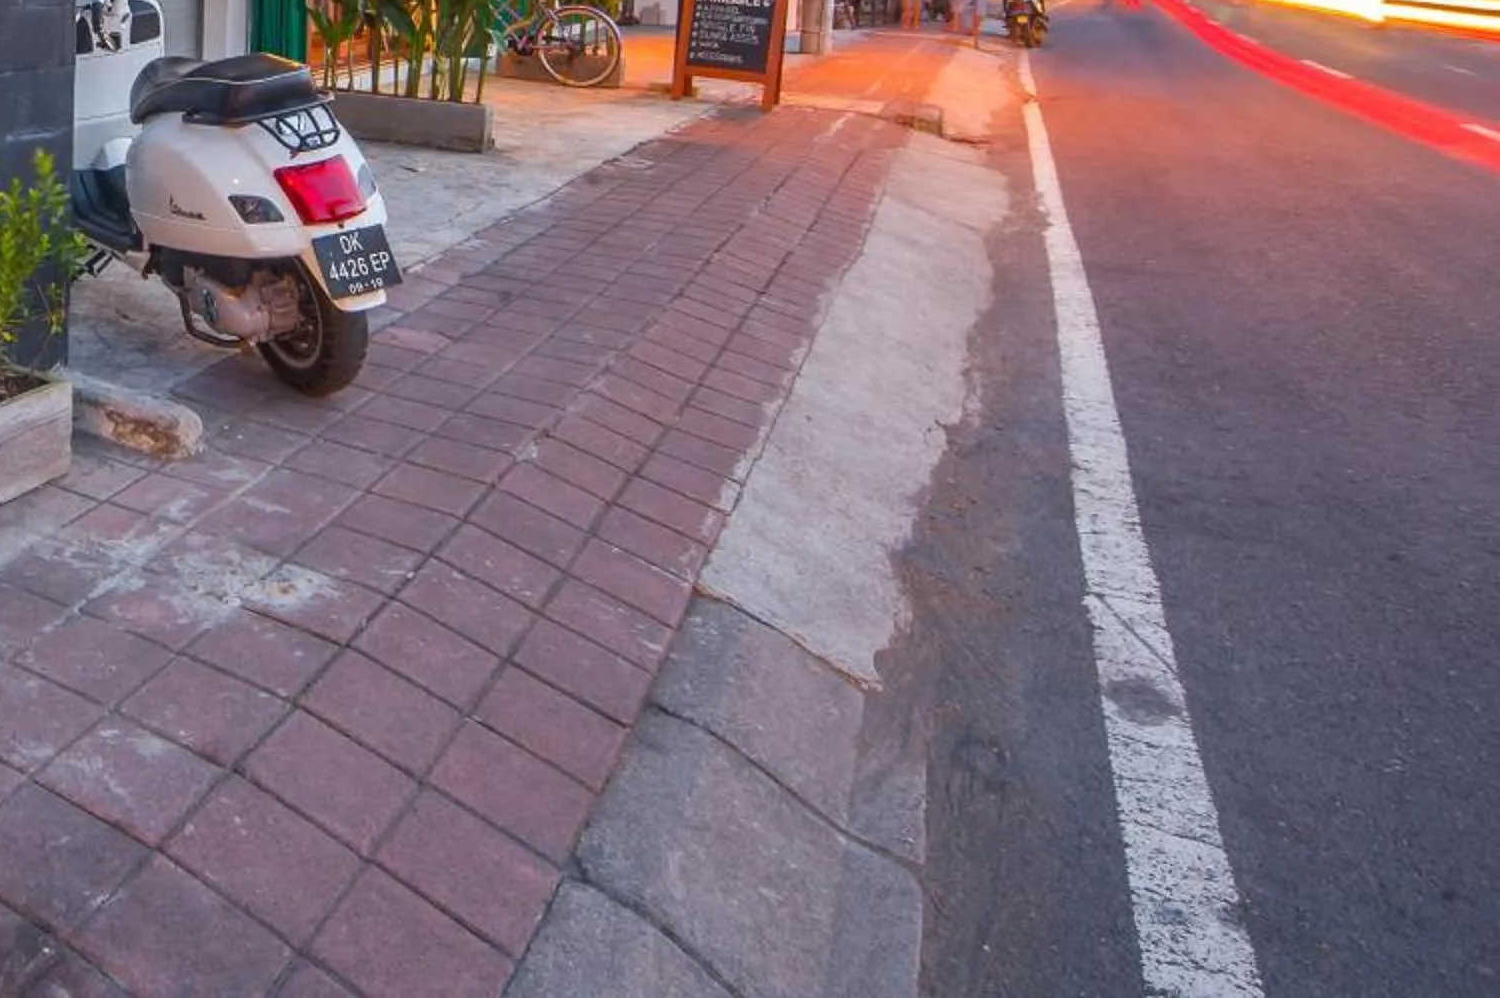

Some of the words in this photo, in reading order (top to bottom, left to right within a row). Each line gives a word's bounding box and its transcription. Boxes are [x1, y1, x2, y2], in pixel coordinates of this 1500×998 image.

[339, 231, 364, 254] DK
[329, 257, 369, 281] 4426
[369, 251, 390, 272] EP
